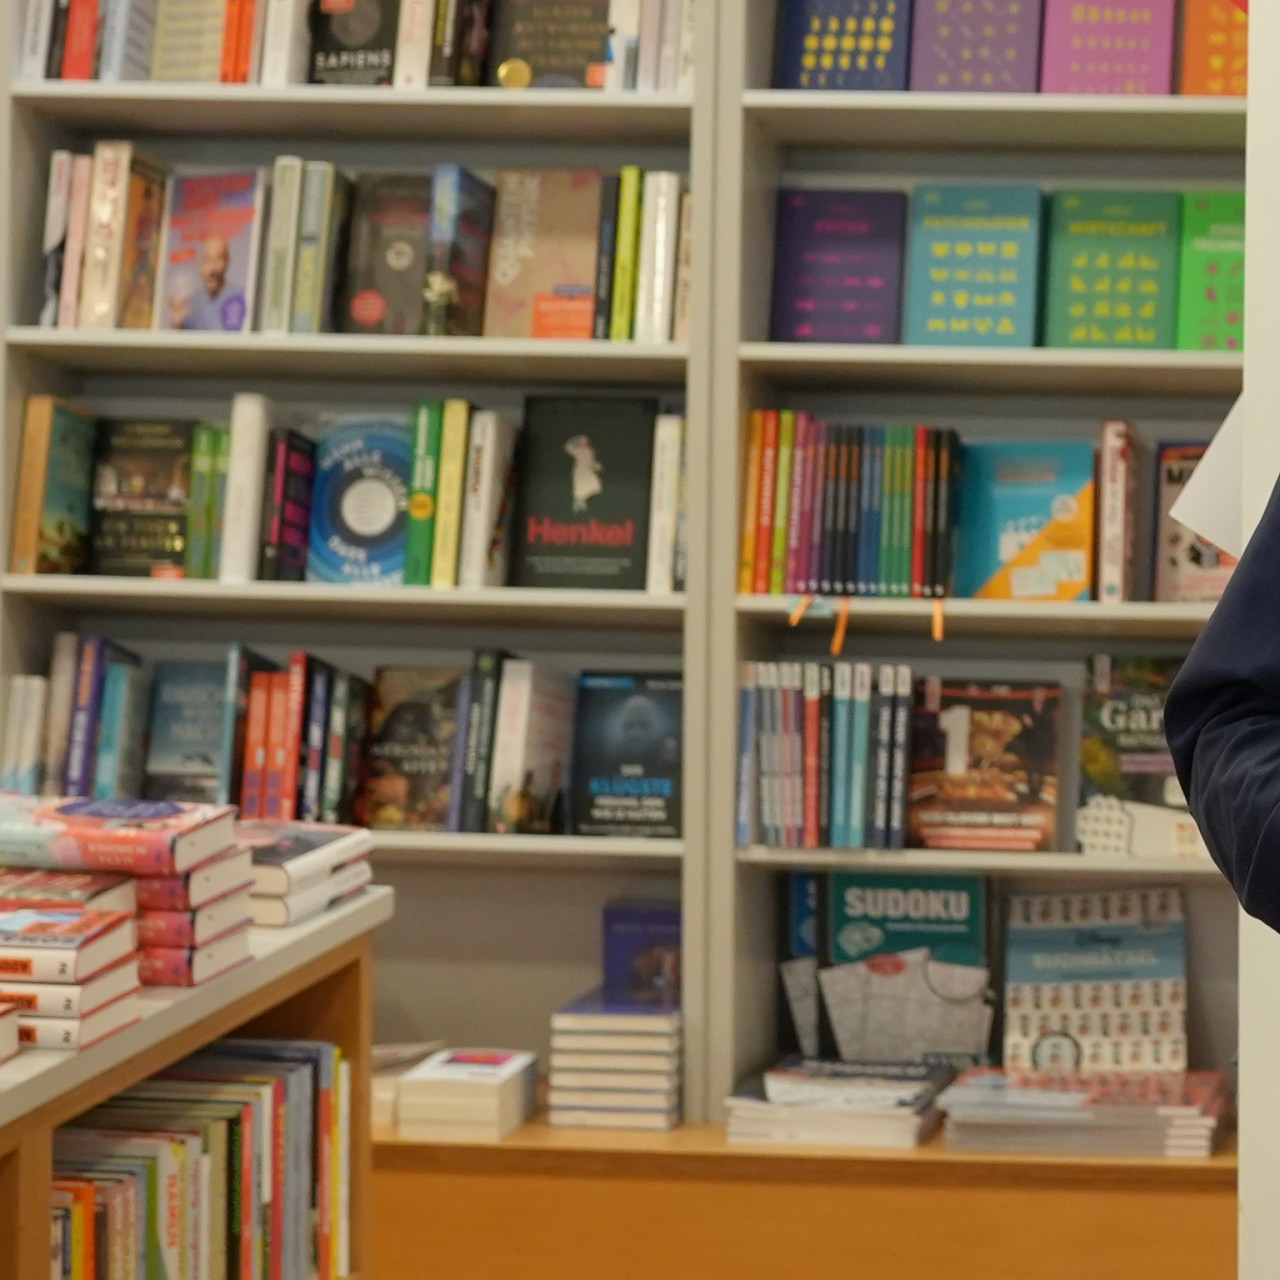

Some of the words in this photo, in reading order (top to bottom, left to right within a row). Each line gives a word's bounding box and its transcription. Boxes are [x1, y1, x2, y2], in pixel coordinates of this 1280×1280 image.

[314, 49, 392, 70] SAPIENS
[527, 515, 635, 547] Henkel
[843, 886, 971, 921] SUDOKU
